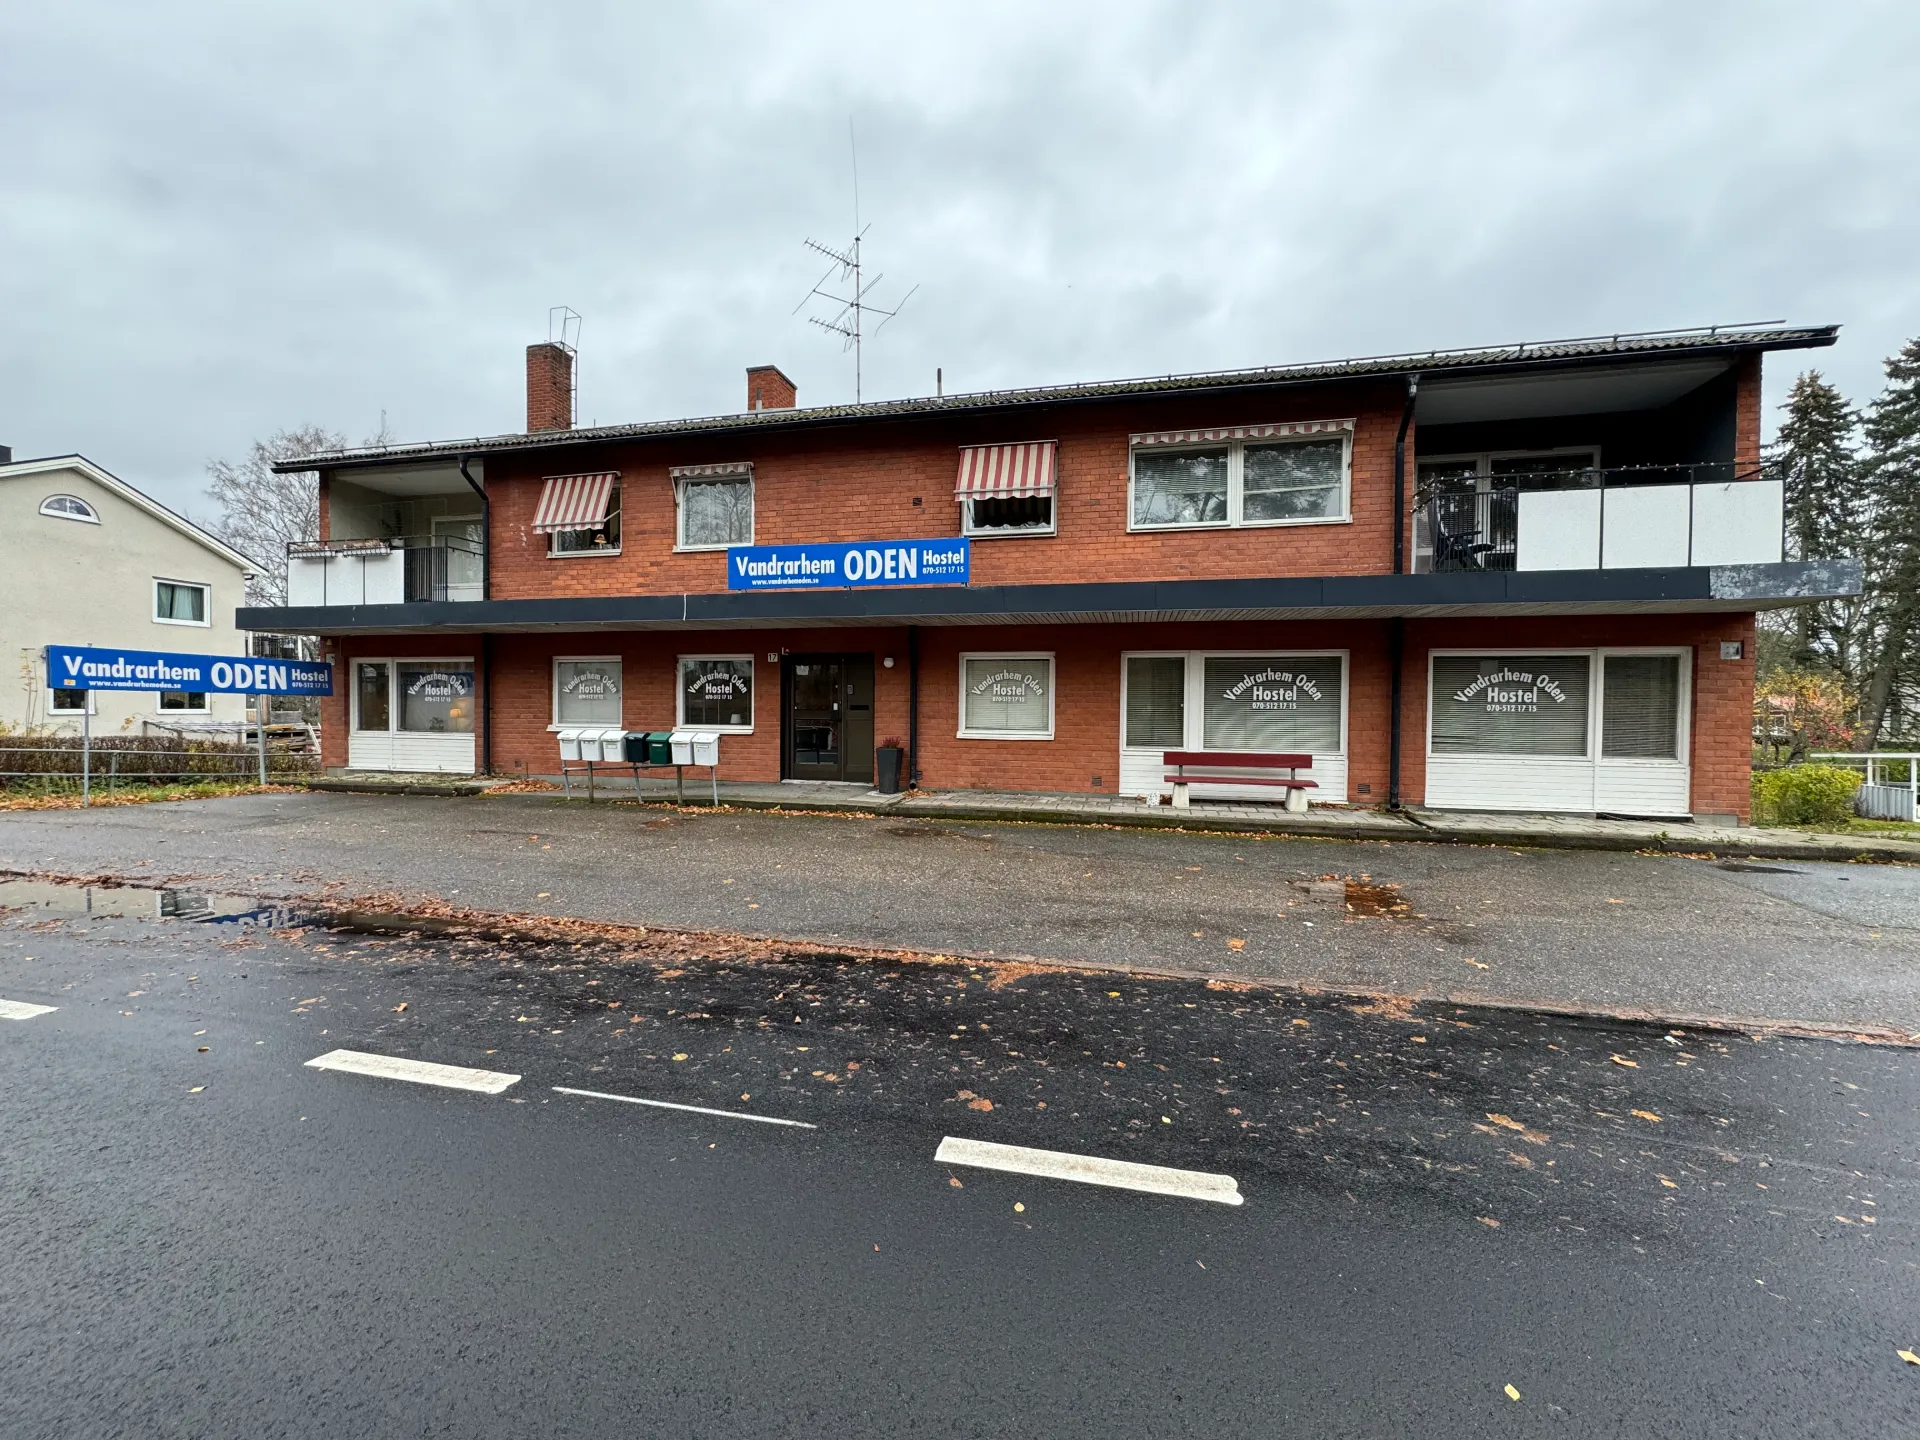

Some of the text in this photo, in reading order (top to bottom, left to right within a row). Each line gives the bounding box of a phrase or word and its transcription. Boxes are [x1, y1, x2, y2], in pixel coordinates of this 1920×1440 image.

[923, 547, 964, 565] Hostel
[736, 548, 917, 580] Vandrarhem ODEN
[923, 566, 946, 574] 070-512
[752, 576, 819, 585] www.vandrarhemoden.se
[768, 653, 777, 661] 17
[62, 655, 287, 690] Vandrarhem ODEN
[291, 668, 328, 682] Hostel
[88, 680, 181, 689] www.vandrarhemoden.se
[408, 670, 465, 695] Vandrarhem Oden
[563, 671, 617, 693] Vandrarhem Oden
[579, 683, 603, 693] Hostel
[688, 670, 747, 693] Vandrarhem Oden
[706, 682, 732, 693] Hostel
[972, 669, 1043, 695] Vandrarhem Oden
[1223, 668, 1322, 700] Vandrarhem Oden
[1453, 667, 1566, 703] Vandrarhem Oden
[425, 684, 450, 695] Hostel
[994, 684, 1025, 695] Hostel
[1253, 686, 1296, 700] Hostel
[1488, 686, 1537, 702] Hostel
